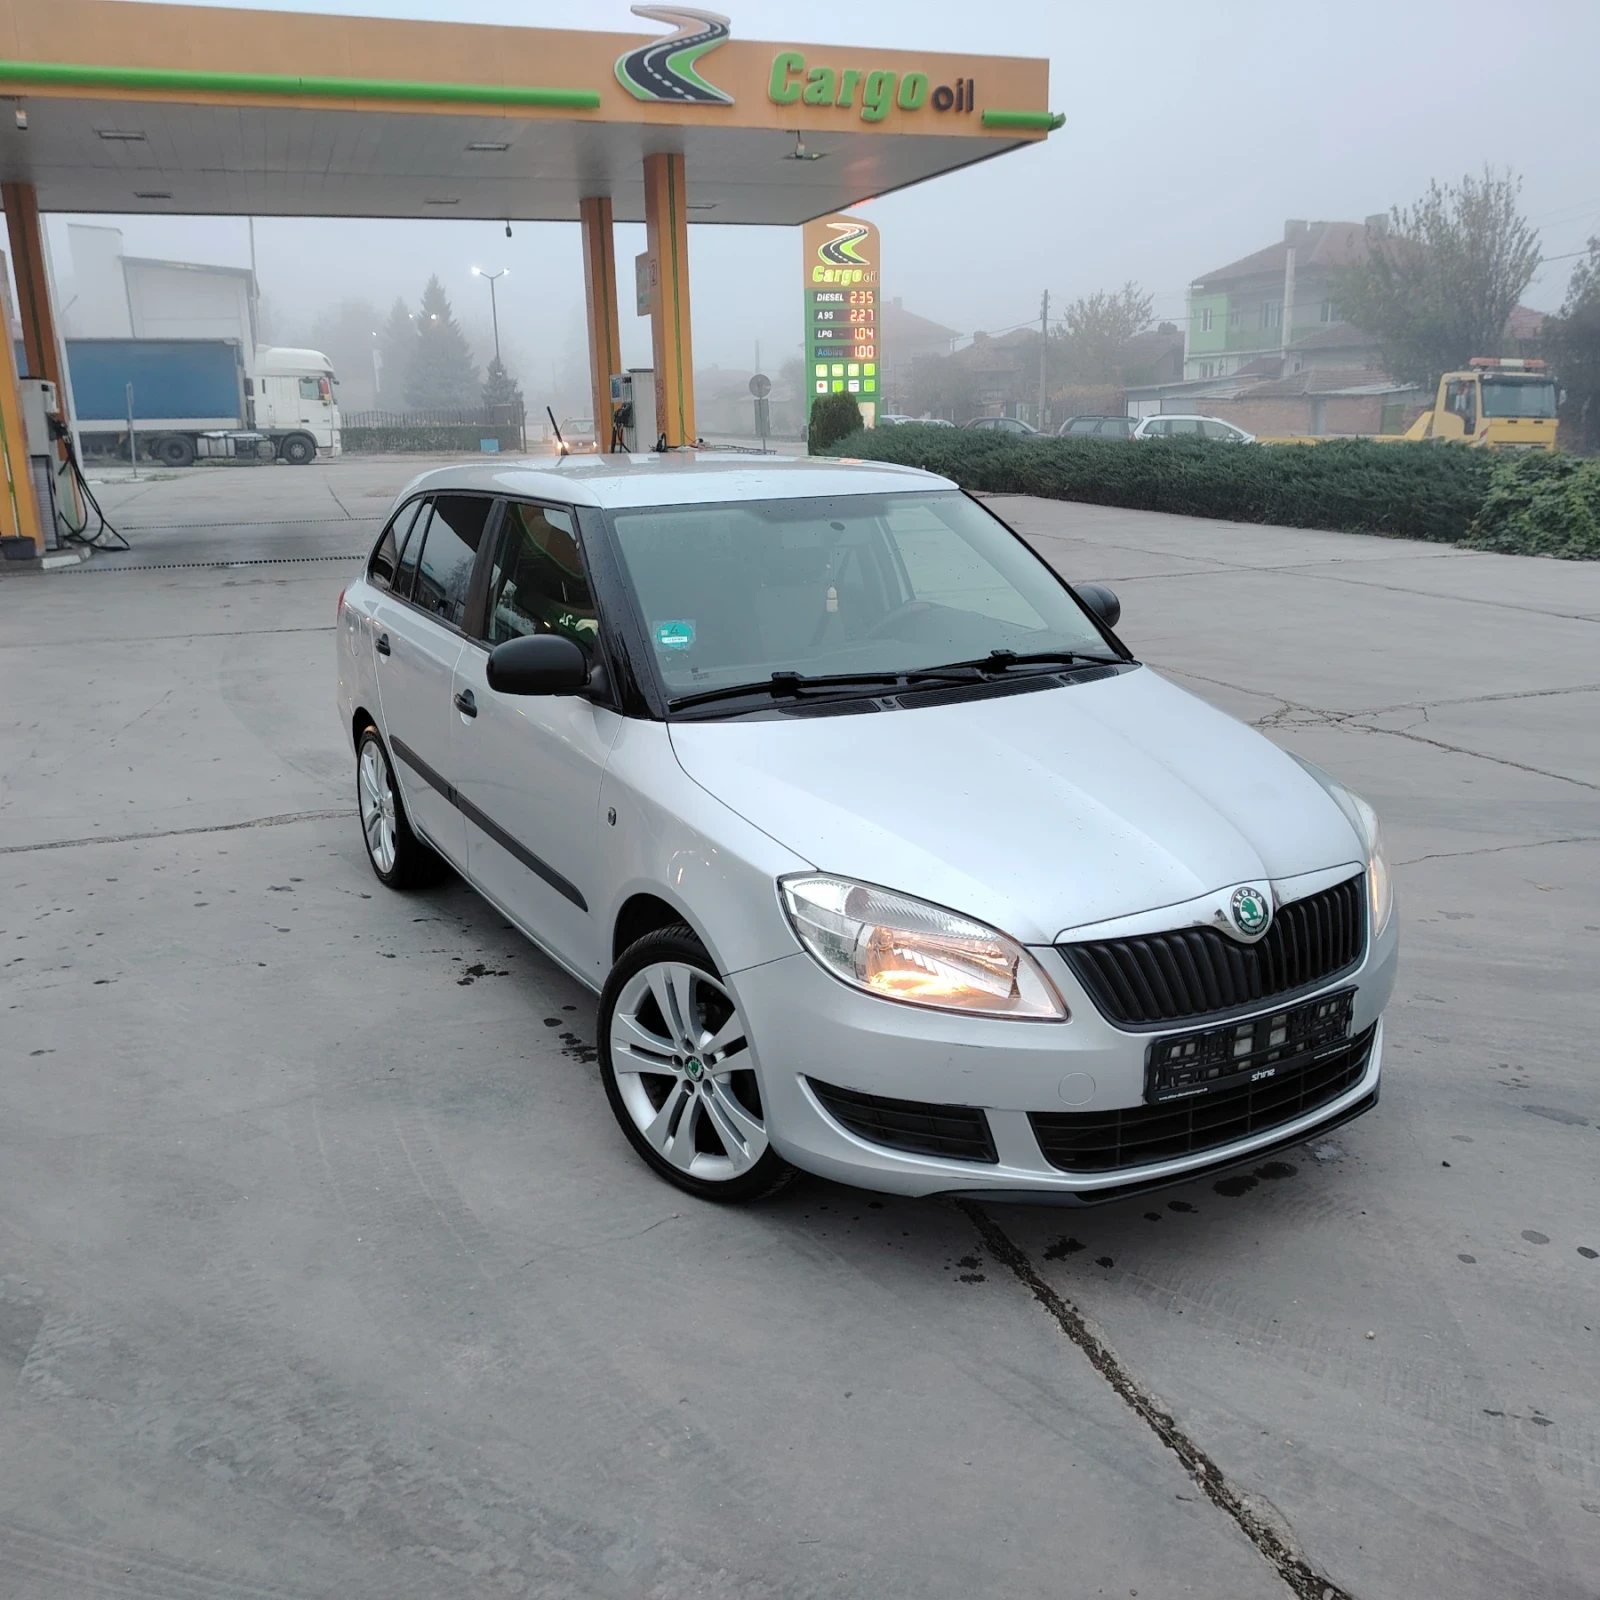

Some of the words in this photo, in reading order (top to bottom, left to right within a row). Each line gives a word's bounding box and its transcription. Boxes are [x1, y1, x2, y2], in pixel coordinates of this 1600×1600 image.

[768, 51, 929, 123] Cargo
[932, 78, 974, 113] oil
[813, 265, 862, 286] Cargo
[816, 293, 844, 302] DIESEL
[850, 290, 874, 304] 2.35
[850, 308, 874, 322] 2.27
[817, 330, 833, 338] LPG
[854, 327, 874, 340] 1.04
[854, 345, 874, 358] 1.00
[1251, 1068, 1276, 1082] shine
